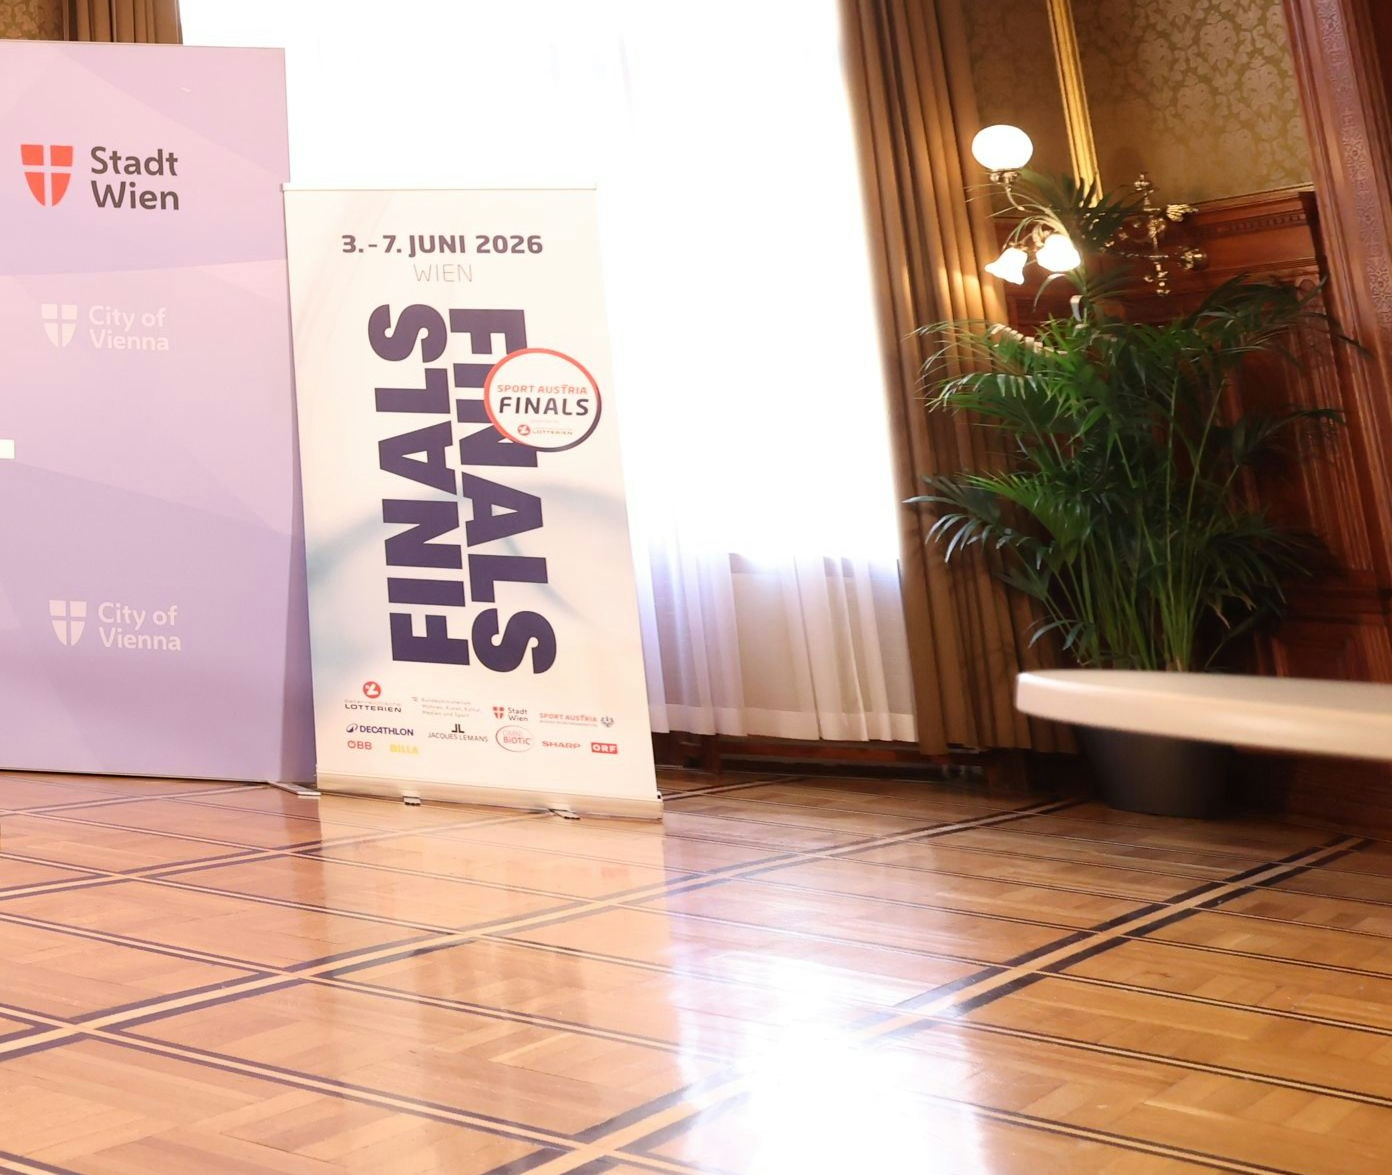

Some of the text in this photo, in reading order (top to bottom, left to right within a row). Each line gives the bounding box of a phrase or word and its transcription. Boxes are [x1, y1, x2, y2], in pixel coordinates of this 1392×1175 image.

[90, 145, 179, 177] Stadt
[90, 180, 180, 211] Wien
[408, 234, 466, 258] JUNI
[475, 234, 544, 255] 2026
[413, 263, 474, 283] WIEN
[88, 304, 169, 332] City of
[88, 328, 170, 351] Vienna
[497, 384, 588, 395] SPORT AUSTRIA
[499, 396, 590, 416] FINALS
[368, 303, 471, 666] FINALS
[97, 601, 178, 631] City of
[98, 626, 182, 651] Vienna
[344, 703, 402, 713] LOTTERIEN
[507, 706, 528, 715] Stadt
[508, 714, 528, 722] Wien
[359, 725, 414, 736] DECATHLON
[592, 744, 616, 753] ORF
